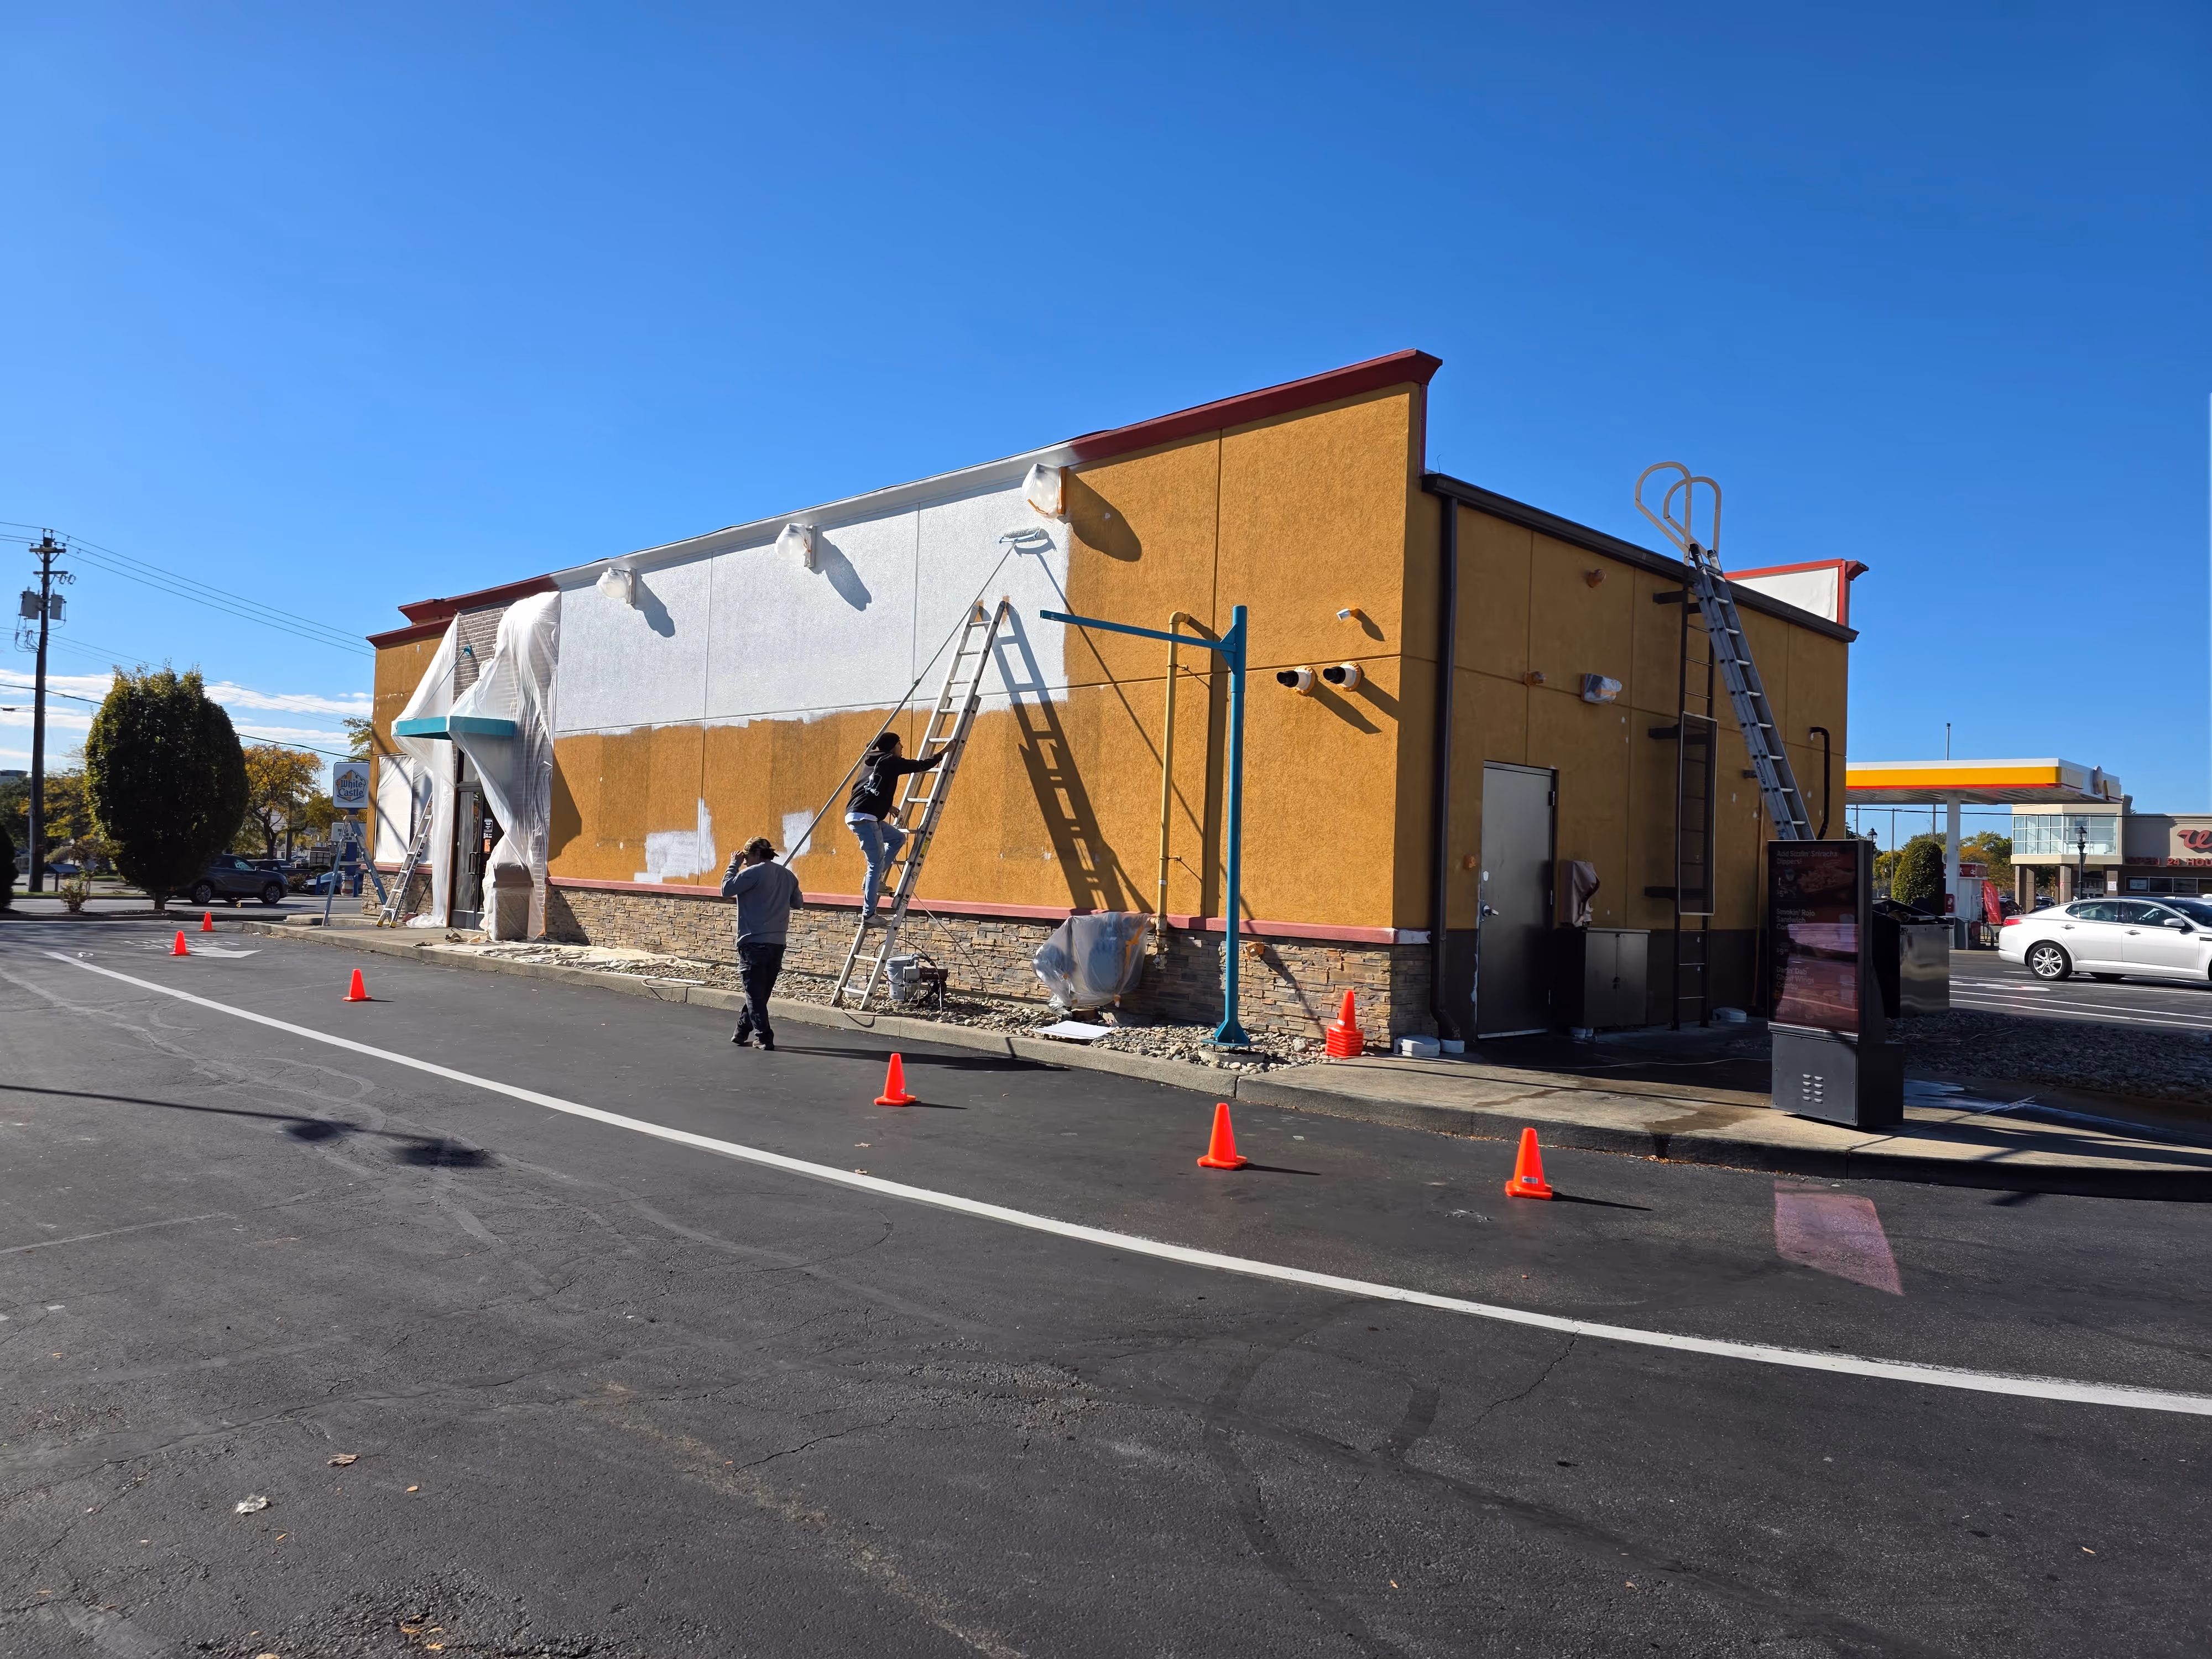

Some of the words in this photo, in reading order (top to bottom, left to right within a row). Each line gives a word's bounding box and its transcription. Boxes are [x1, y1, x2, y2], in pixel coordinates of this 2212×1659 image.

[340, 779, 363, 789] White
[338, 788, 364, 797] Castle
[2168, 858, 2180, 866] 24
[1776, 908, 1801, 916] Smokin'
[1801, 909, 1815, 917] Rojo
[1776, 973, 1794, 982] Ghost
[1794, 975, 1814, 984] Wings
[1776, 982, 1798, 990] Combo
